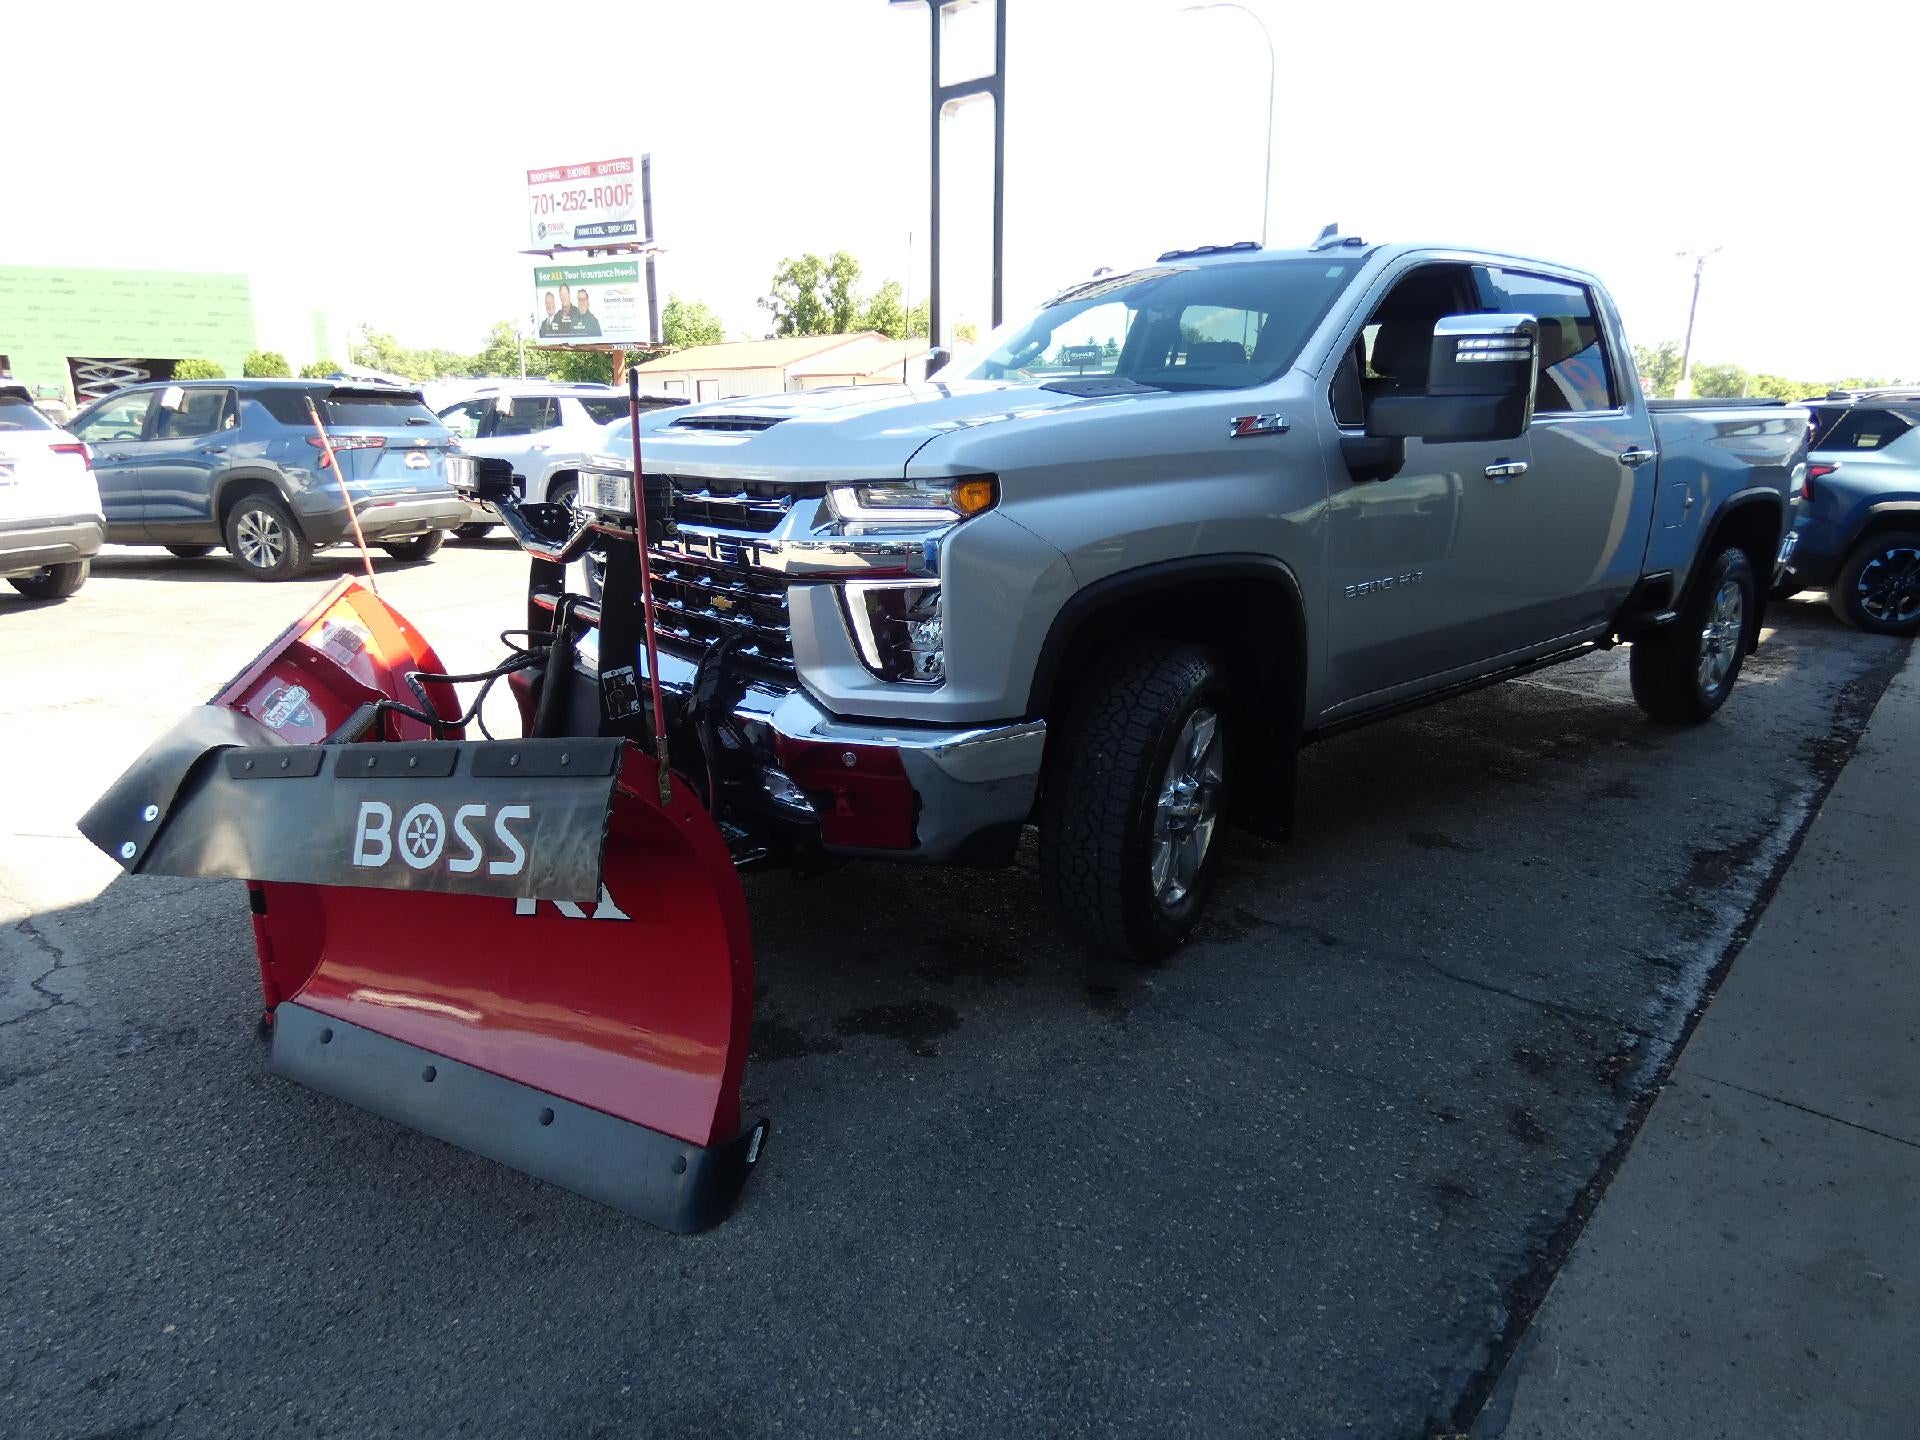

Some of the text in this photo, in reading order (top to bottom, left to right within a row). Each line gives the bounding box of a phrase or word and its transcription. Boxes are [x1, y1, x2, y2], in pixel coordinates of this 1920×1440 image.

[566, 165, 591, 179] SIDING
[597, 161, 631, 175] GUTTERS
[531, 183, 633, 215] 701-252-ROOF
[539, 265, 637, 282] For ALL Your Insurance Needs
[1230, 413, 1290, 437] Z71
[352, 800, 531, 877] BOSS
